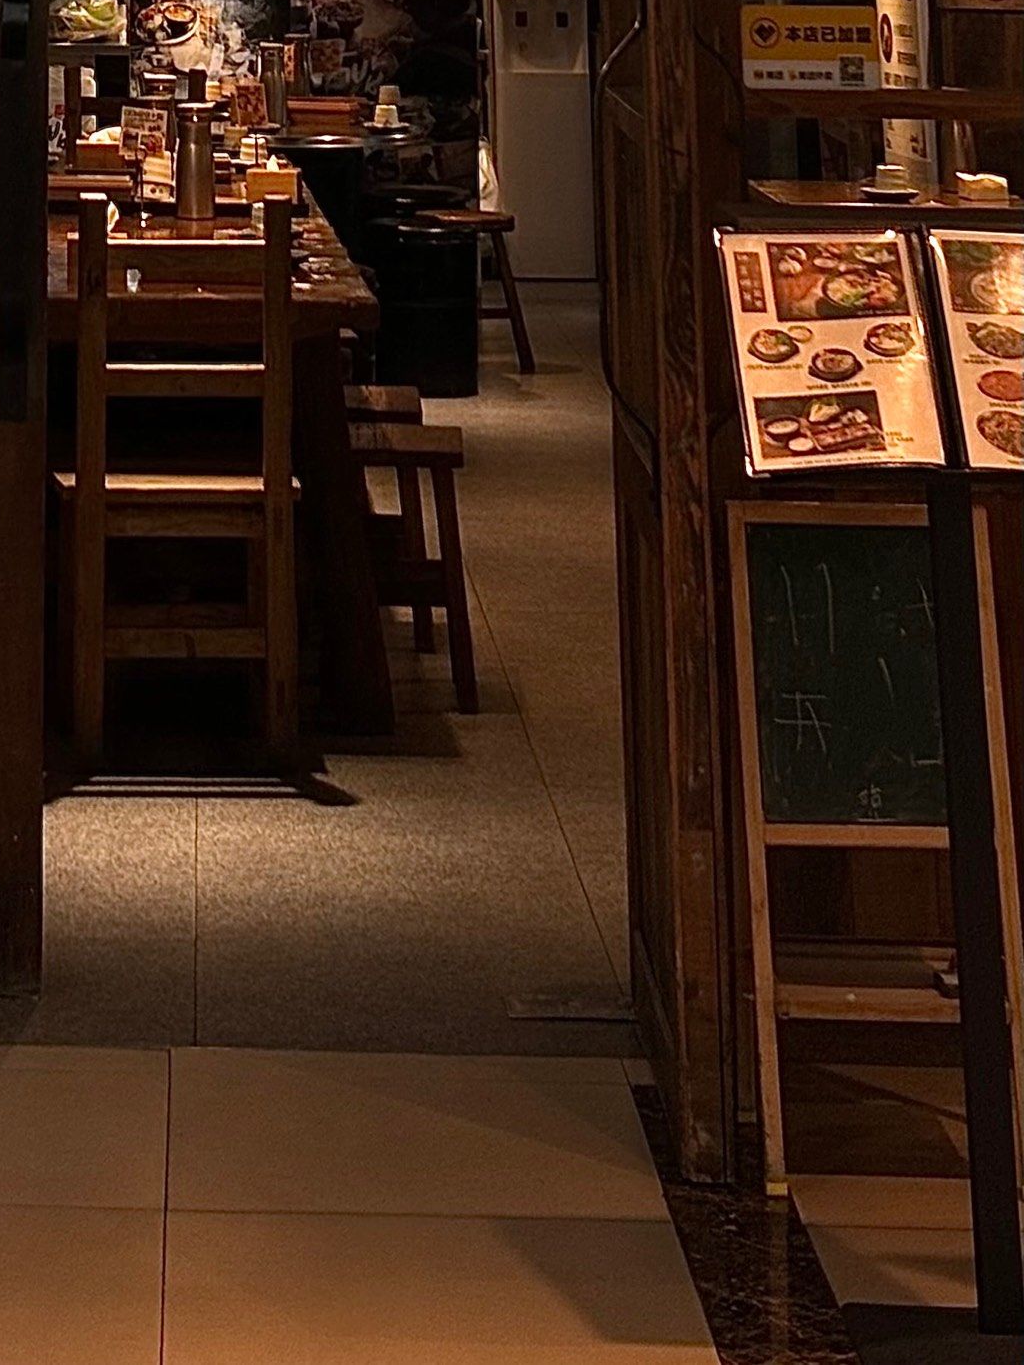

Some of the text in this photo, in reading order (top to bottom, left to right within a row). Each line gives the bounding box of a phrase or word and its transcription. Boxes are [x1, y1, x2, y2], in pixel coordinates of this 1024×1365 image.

[785, 25, 871, 43] 本店已加盟
